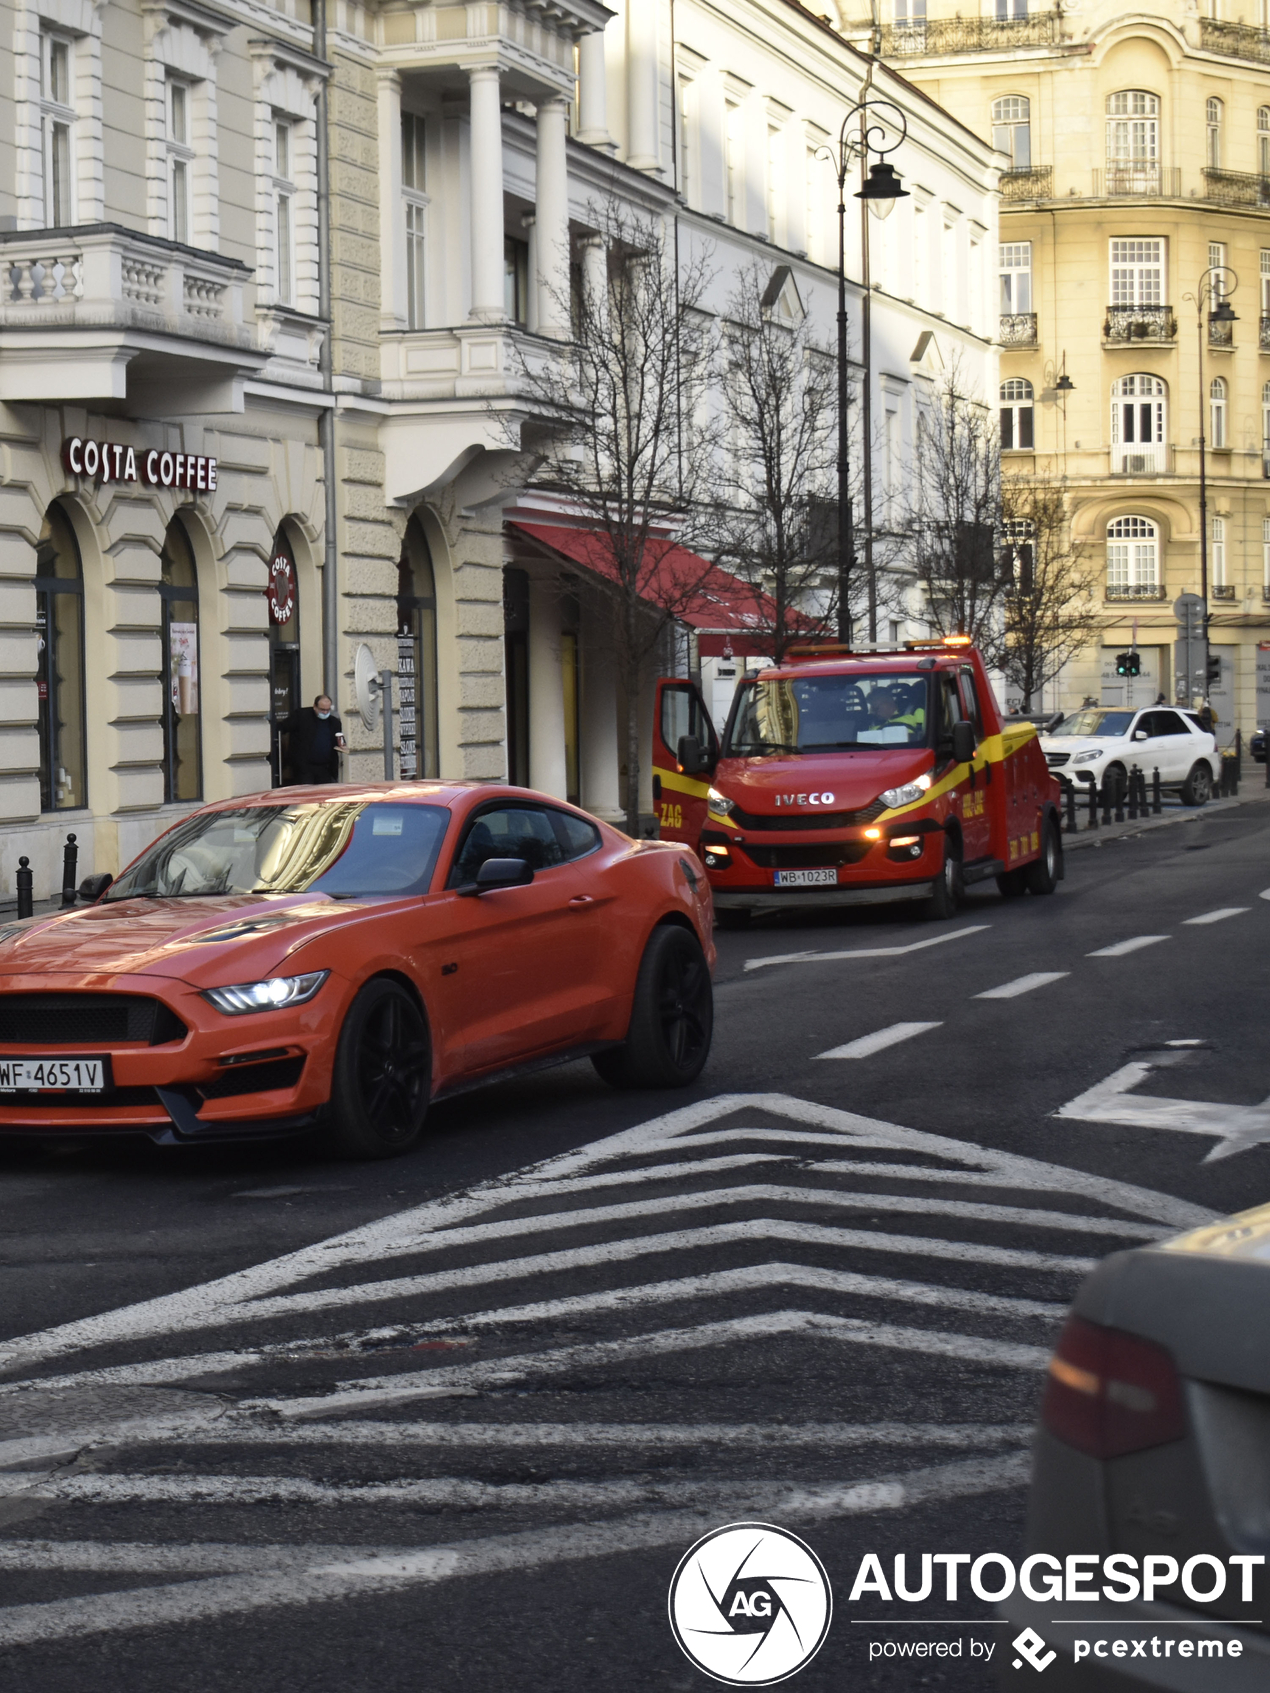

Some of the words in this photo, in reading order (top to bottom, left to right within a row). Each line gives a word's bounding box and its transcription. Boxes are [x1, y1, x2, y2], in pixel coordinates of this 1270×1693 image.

[69, 437, 137, 483] COSTA
[146, 449, 217, 491] COFFEE
[271, 556, 291, 577] COSTA
[271, 597, 293, 622] COFFEE
[774, 792, 836, 807] IVECO
[780, 871, 797, 883] WB
[801, 870, 836, 883] 1023R
[33, 1063, 97, 1086] 4651V
